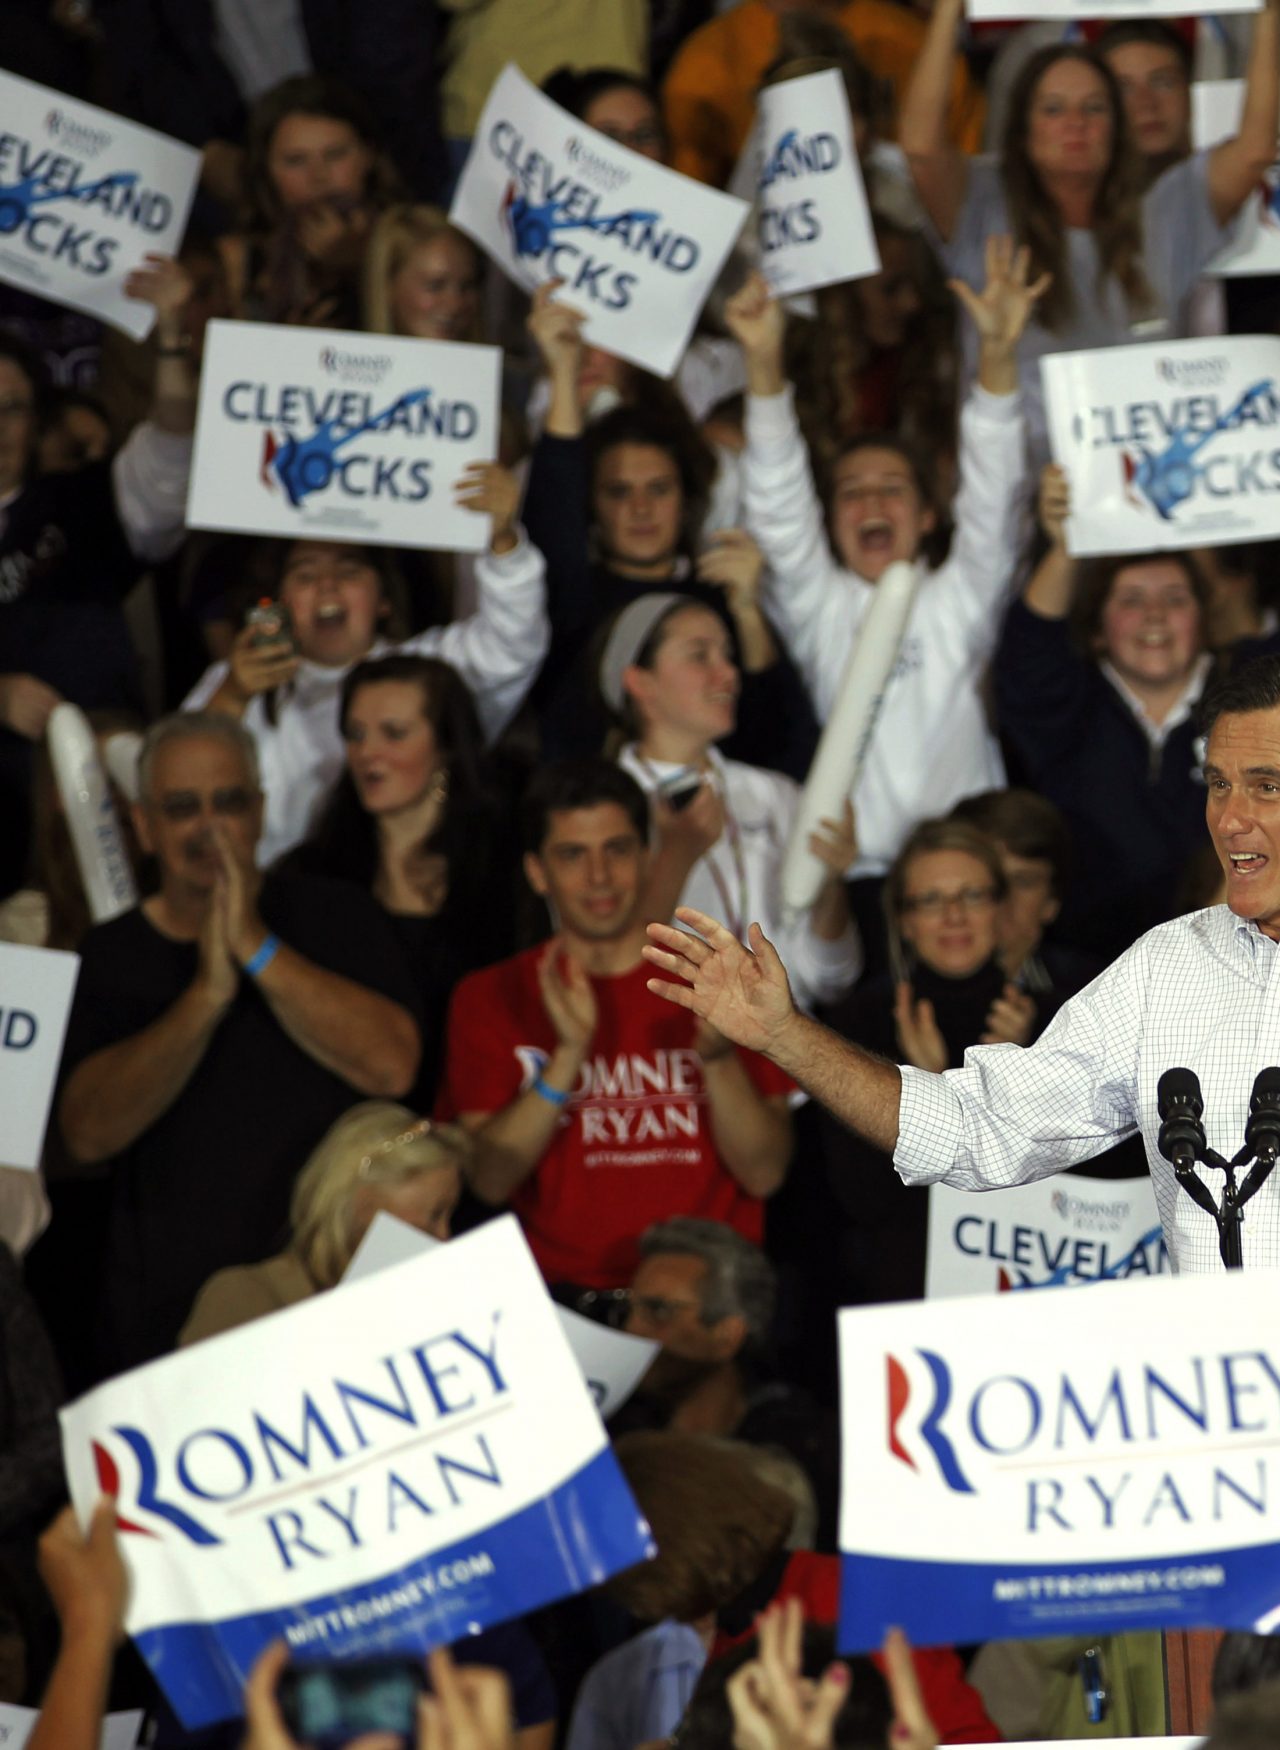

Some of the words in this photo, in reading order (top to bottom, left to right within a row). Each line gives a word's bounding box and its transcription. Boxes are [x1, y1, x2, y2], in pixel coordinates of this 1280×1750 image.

[489, 119, 700, 274] CLEVELAND
[223, 381, 478, 441] CLEVELAND
[260, 428, 432, 508] ROCKS
[0, 1004, 38, 1050] D
[514, 1045, 704, 1100] OMNE
[581, 1102, 699, 1144] RYAN
[91, 1311, 511, 1546] ROMNEY
[262, 1434, 504, 1571] RYAN
[1026, 1459, 1267, 1533] RYAN
